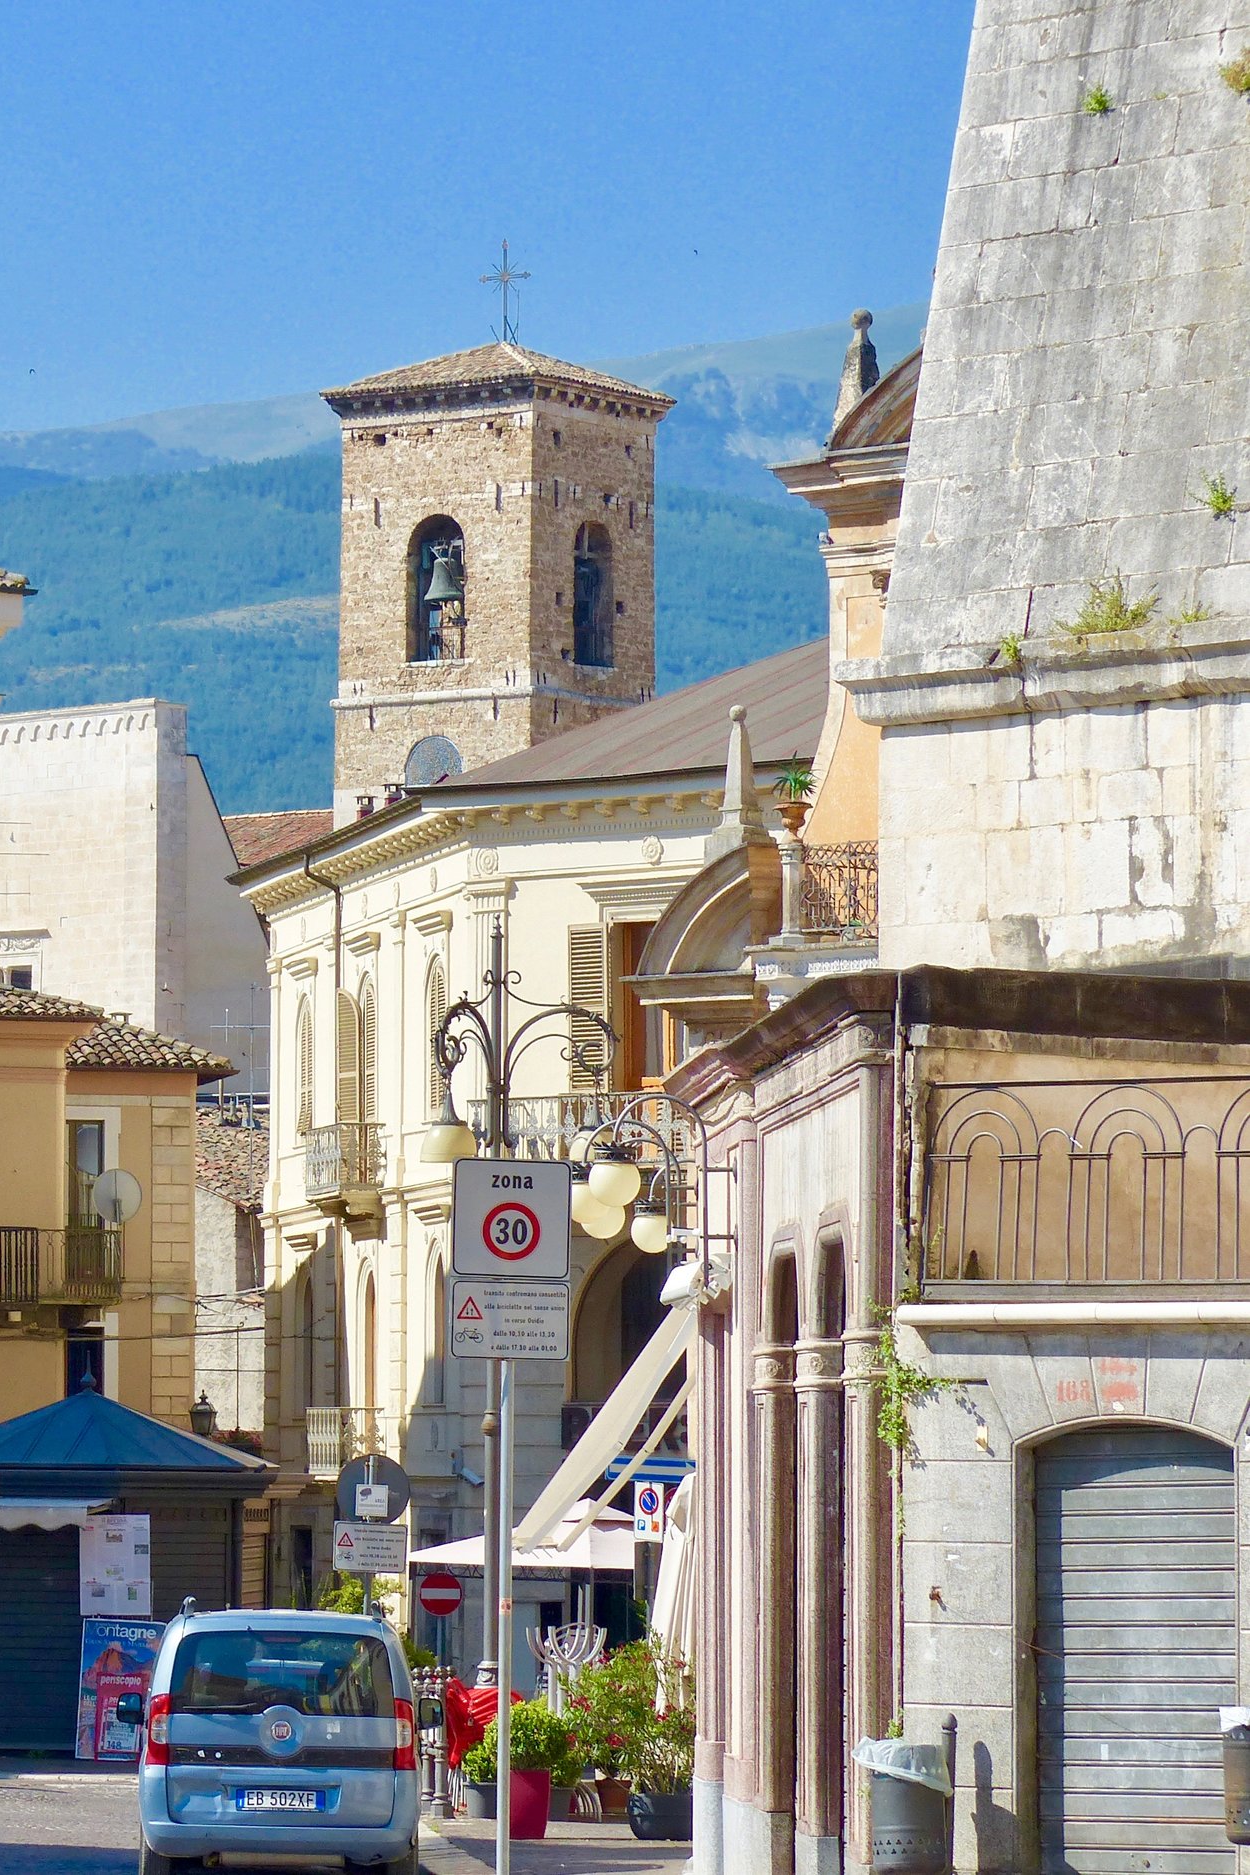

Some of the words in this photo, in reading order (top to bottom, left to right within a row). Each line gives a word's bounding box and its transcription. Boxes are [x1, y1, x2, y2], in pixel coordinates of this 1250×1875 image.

[491, 1174, 533, 1189] zona
[495, 1218, 527, 1245] 30
[100, 1675, 142, 1687] periscopio
[246, 1791, 264, 1806] EB
[269, 1791, 315, 1808] 502XF
